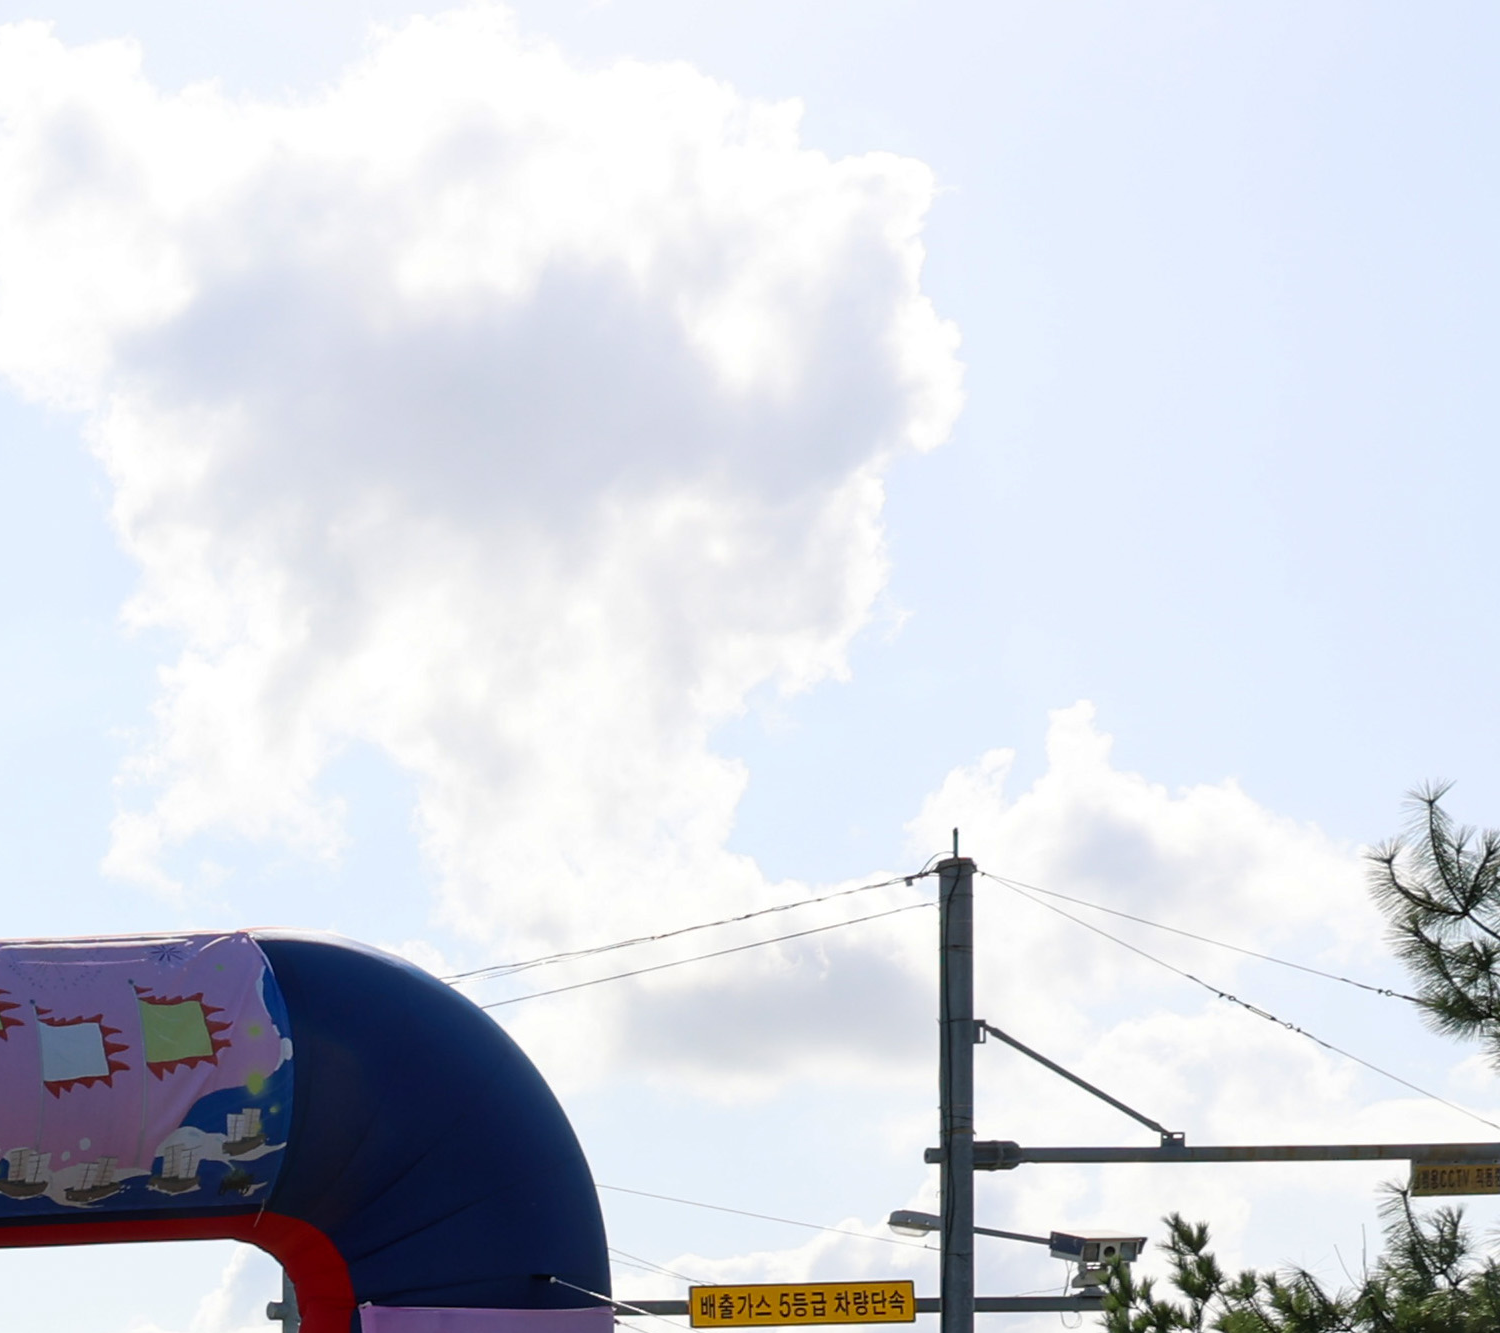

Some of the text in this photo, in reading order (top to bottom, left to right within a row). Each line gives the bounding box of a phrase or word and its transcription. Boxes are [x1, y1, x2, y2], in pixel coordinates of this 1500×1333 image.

[700, 1289, 906, 1319] 배출가스 5등급 차량단속
